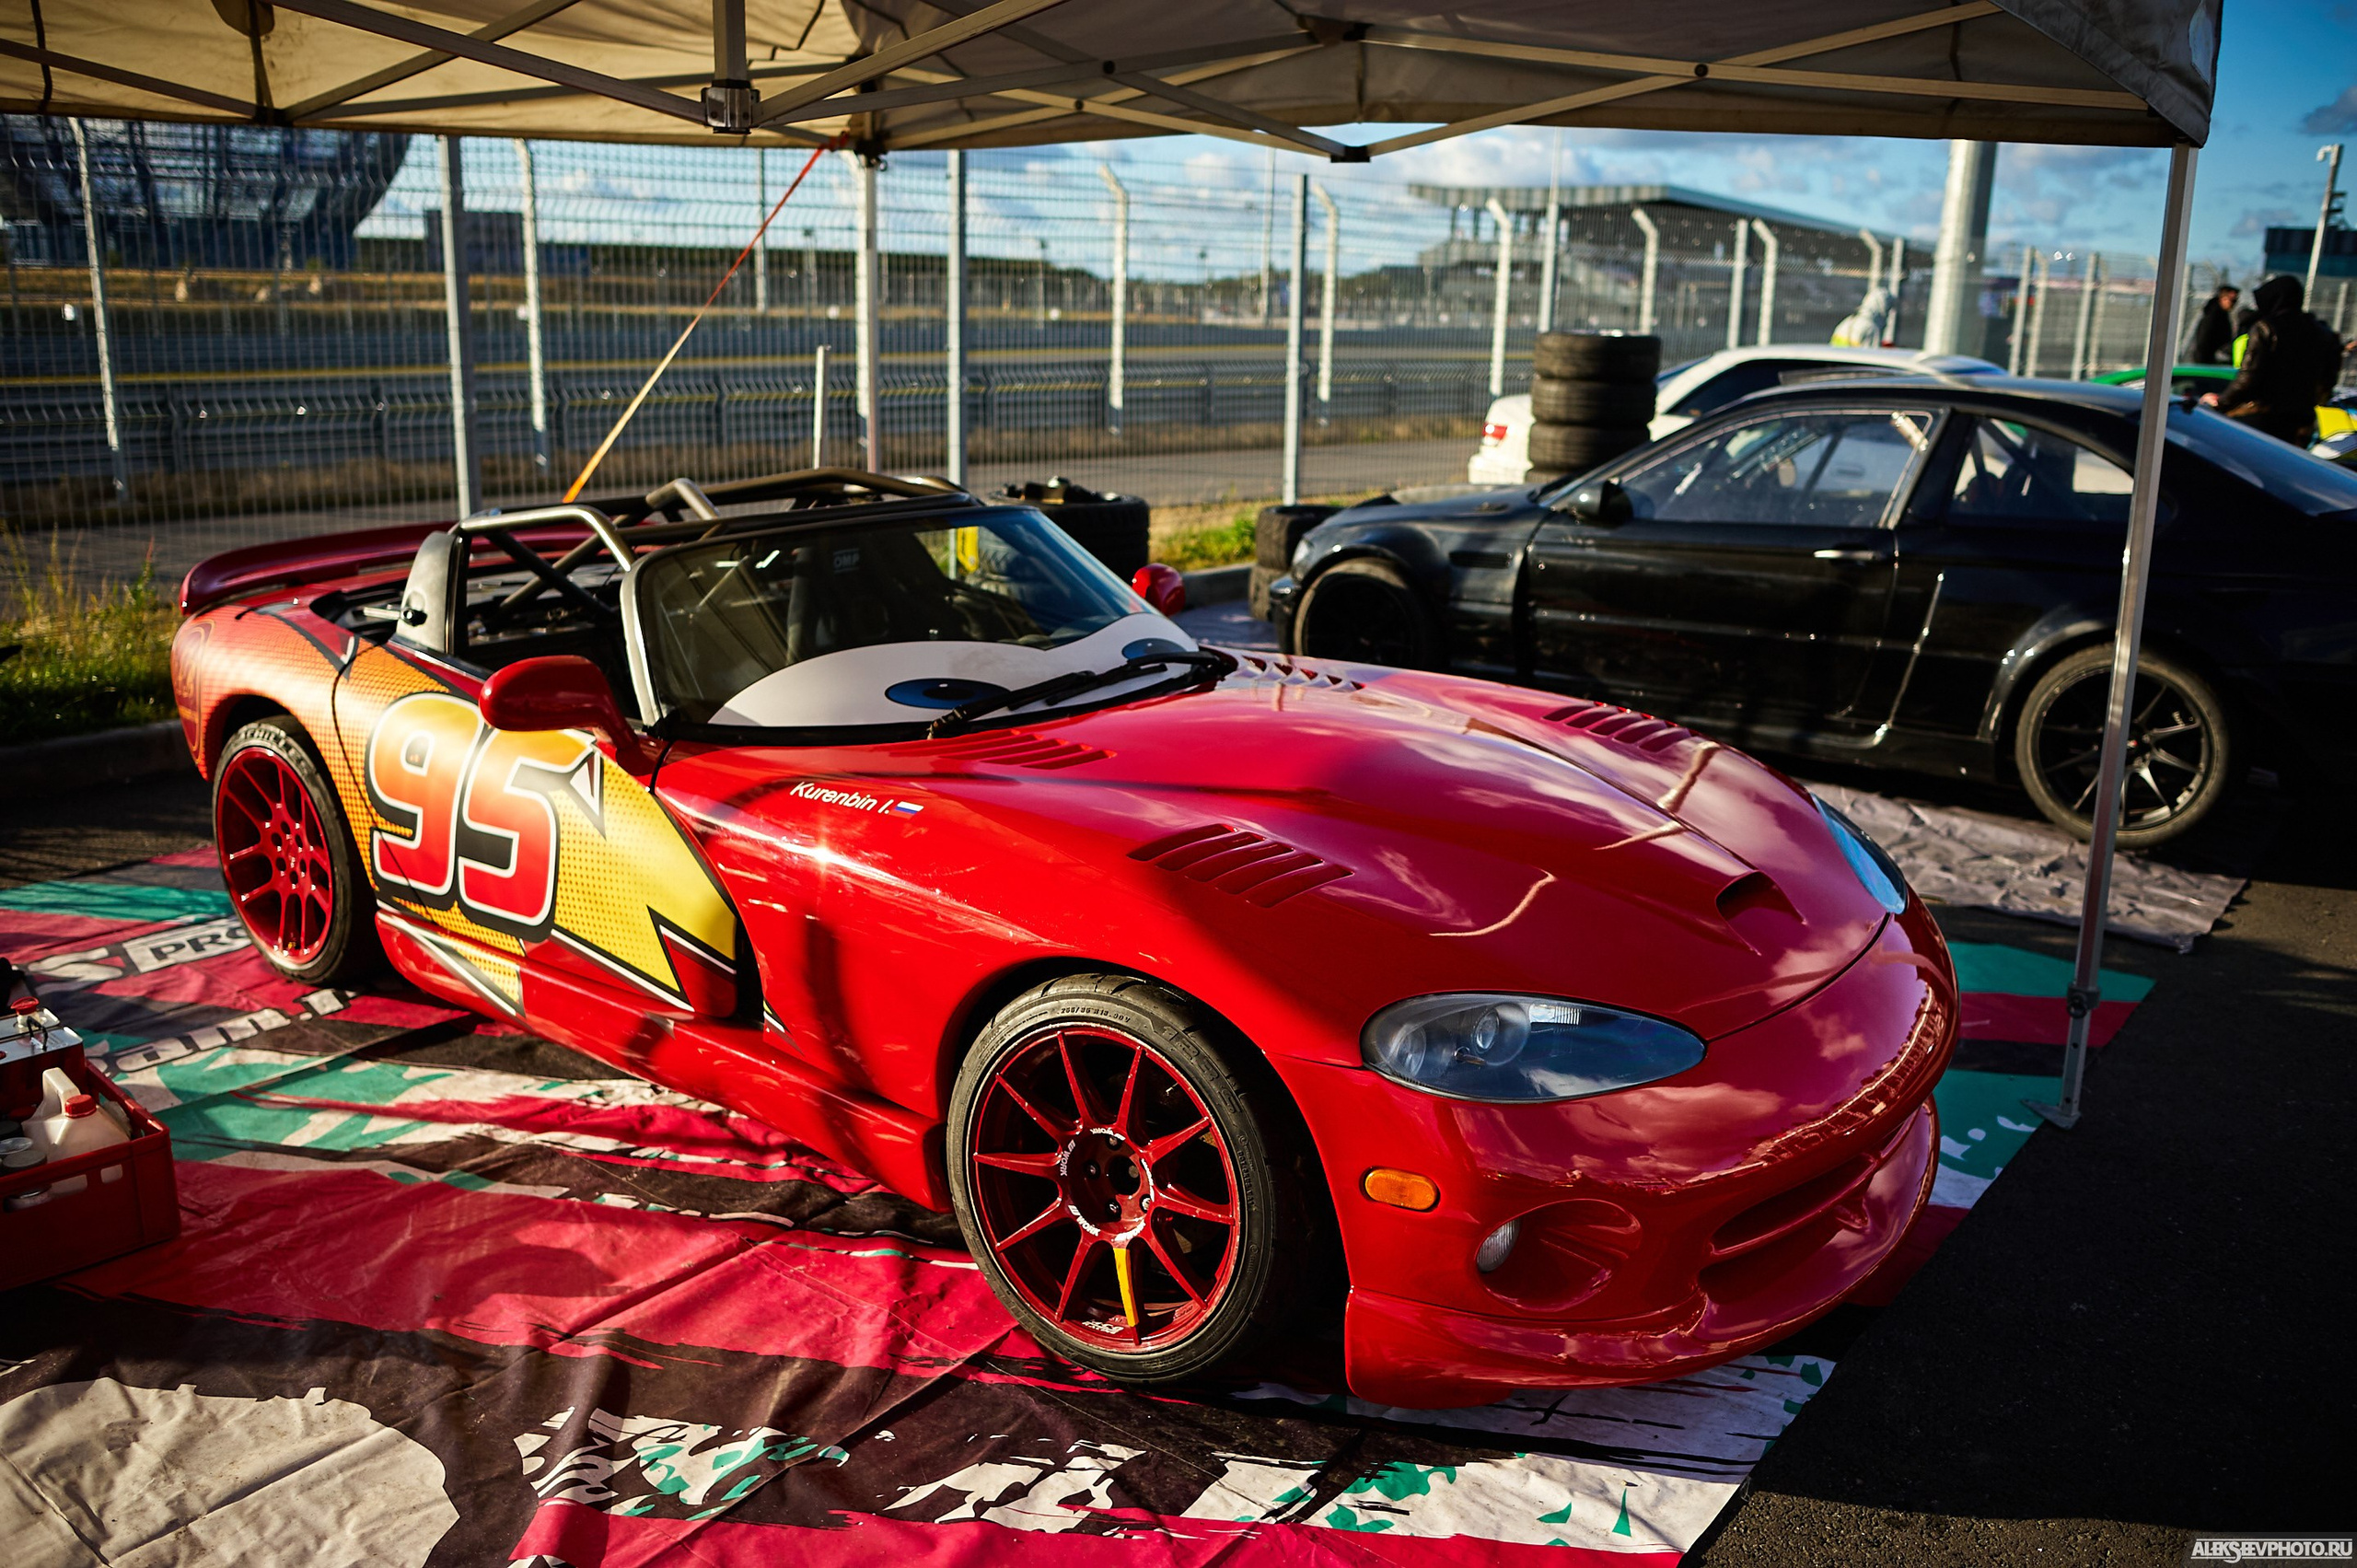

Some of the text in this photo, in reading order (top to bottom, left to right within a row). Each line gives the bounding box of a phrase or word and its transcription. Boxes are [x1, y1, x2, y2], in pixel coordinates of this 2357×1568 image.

[833, 552, 860, 569] OMP
[369, 691, 597, 926] 95
[789, 781, 878, 811] Kurenbin
[1076, 1215, 1101, 1237] WORK
